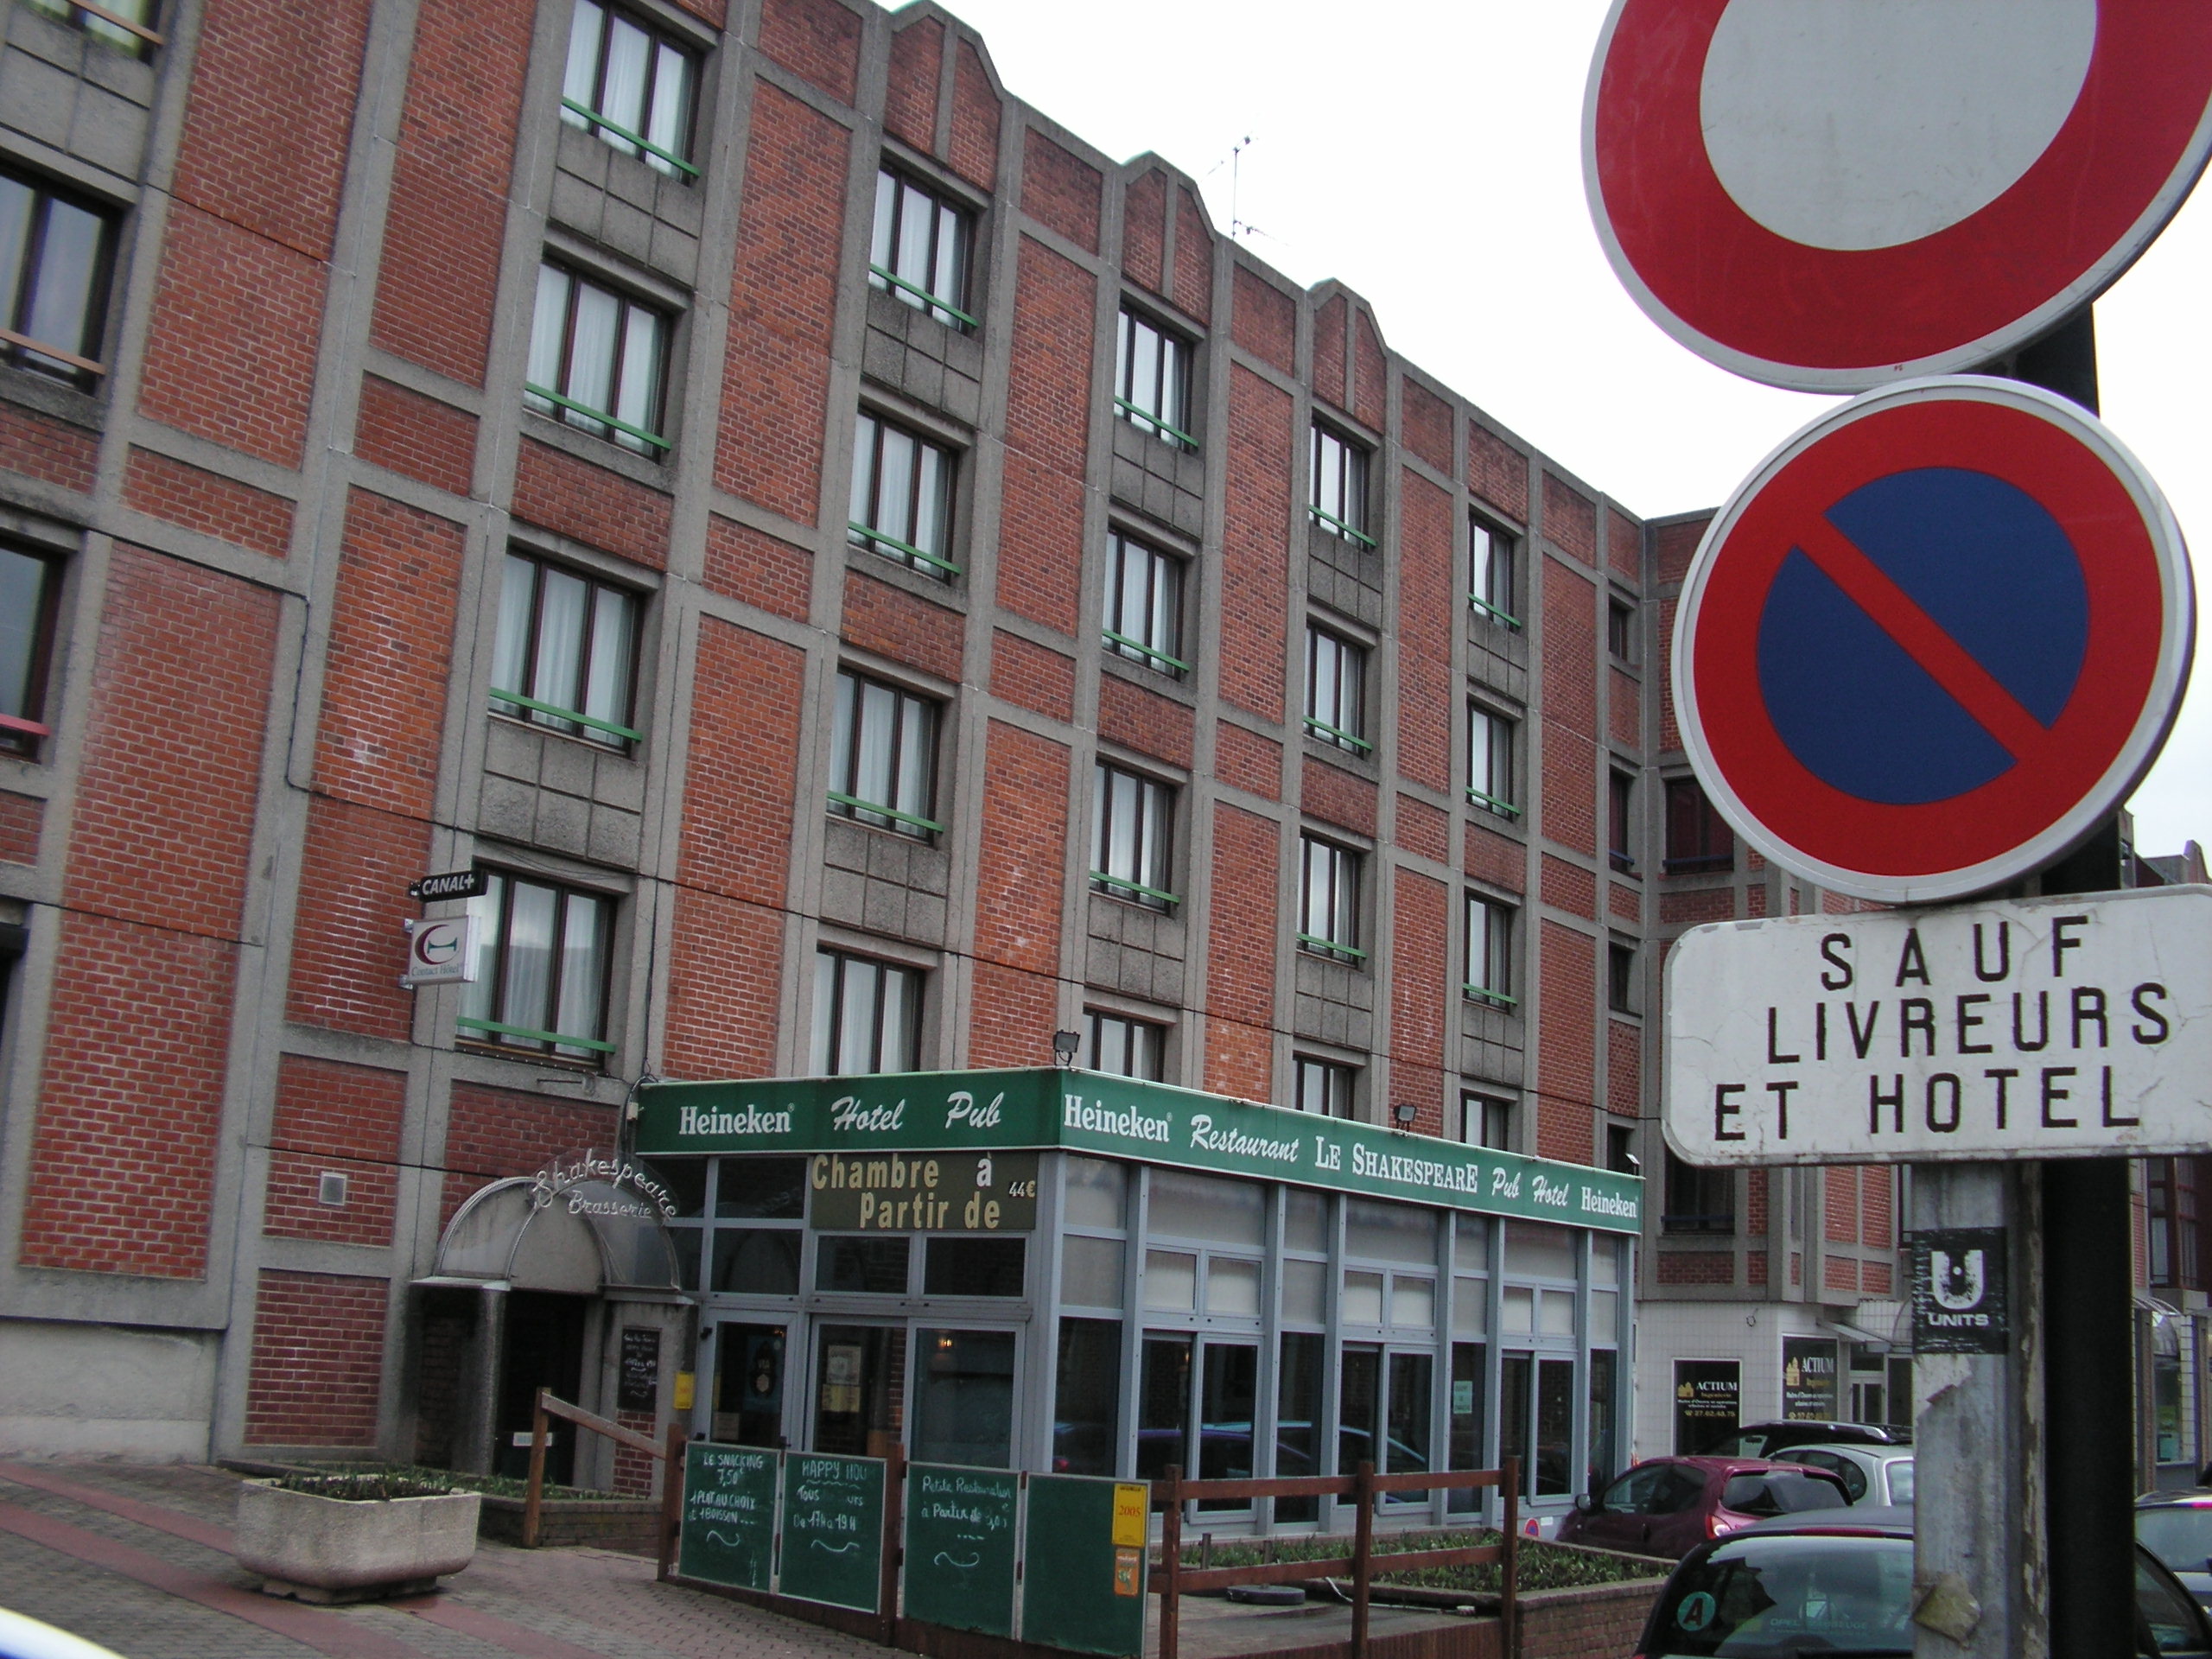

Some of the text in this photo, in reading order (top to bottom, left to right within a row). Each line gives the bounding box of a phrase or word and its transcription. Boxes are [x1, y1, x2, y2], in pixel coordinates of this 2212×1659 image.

[422, 874, 474, 895] CANAL+
[1821, 915, 2088, 991] SAUF
[1768, 982, 2170, 1065] LIVREURS
[679, 1090, 1004, 1135] Heineken Hotel Pub
[1715, 1065, 2140, 1141] ET HOTEL
[1064, 1094, 1637, 1218] Heineken Restaurant LE SHAKESPEARE Pub Hotel Heineken
[532, 1148, 677, 1222] Shakespeare
[812, 1153, 939, 1189] Chambre
[569, 1189, 652, 1218] Brasserie
[860, 1191, 1000, 1229] Partir de
[1928, 1313, 1989, 1327] UNITS
[1801, 1357, 1834, 1373] ACTIUM
[1696, 1381, 1738, 1391] ACTIUM
[703, 1452, 764, 1469] LE SNACKING
[802, 1460, 840, 1479] HAPPY
[1118, 1505, 1141, 1517] 2005
[1683, 1598, 1703, 1626] A
